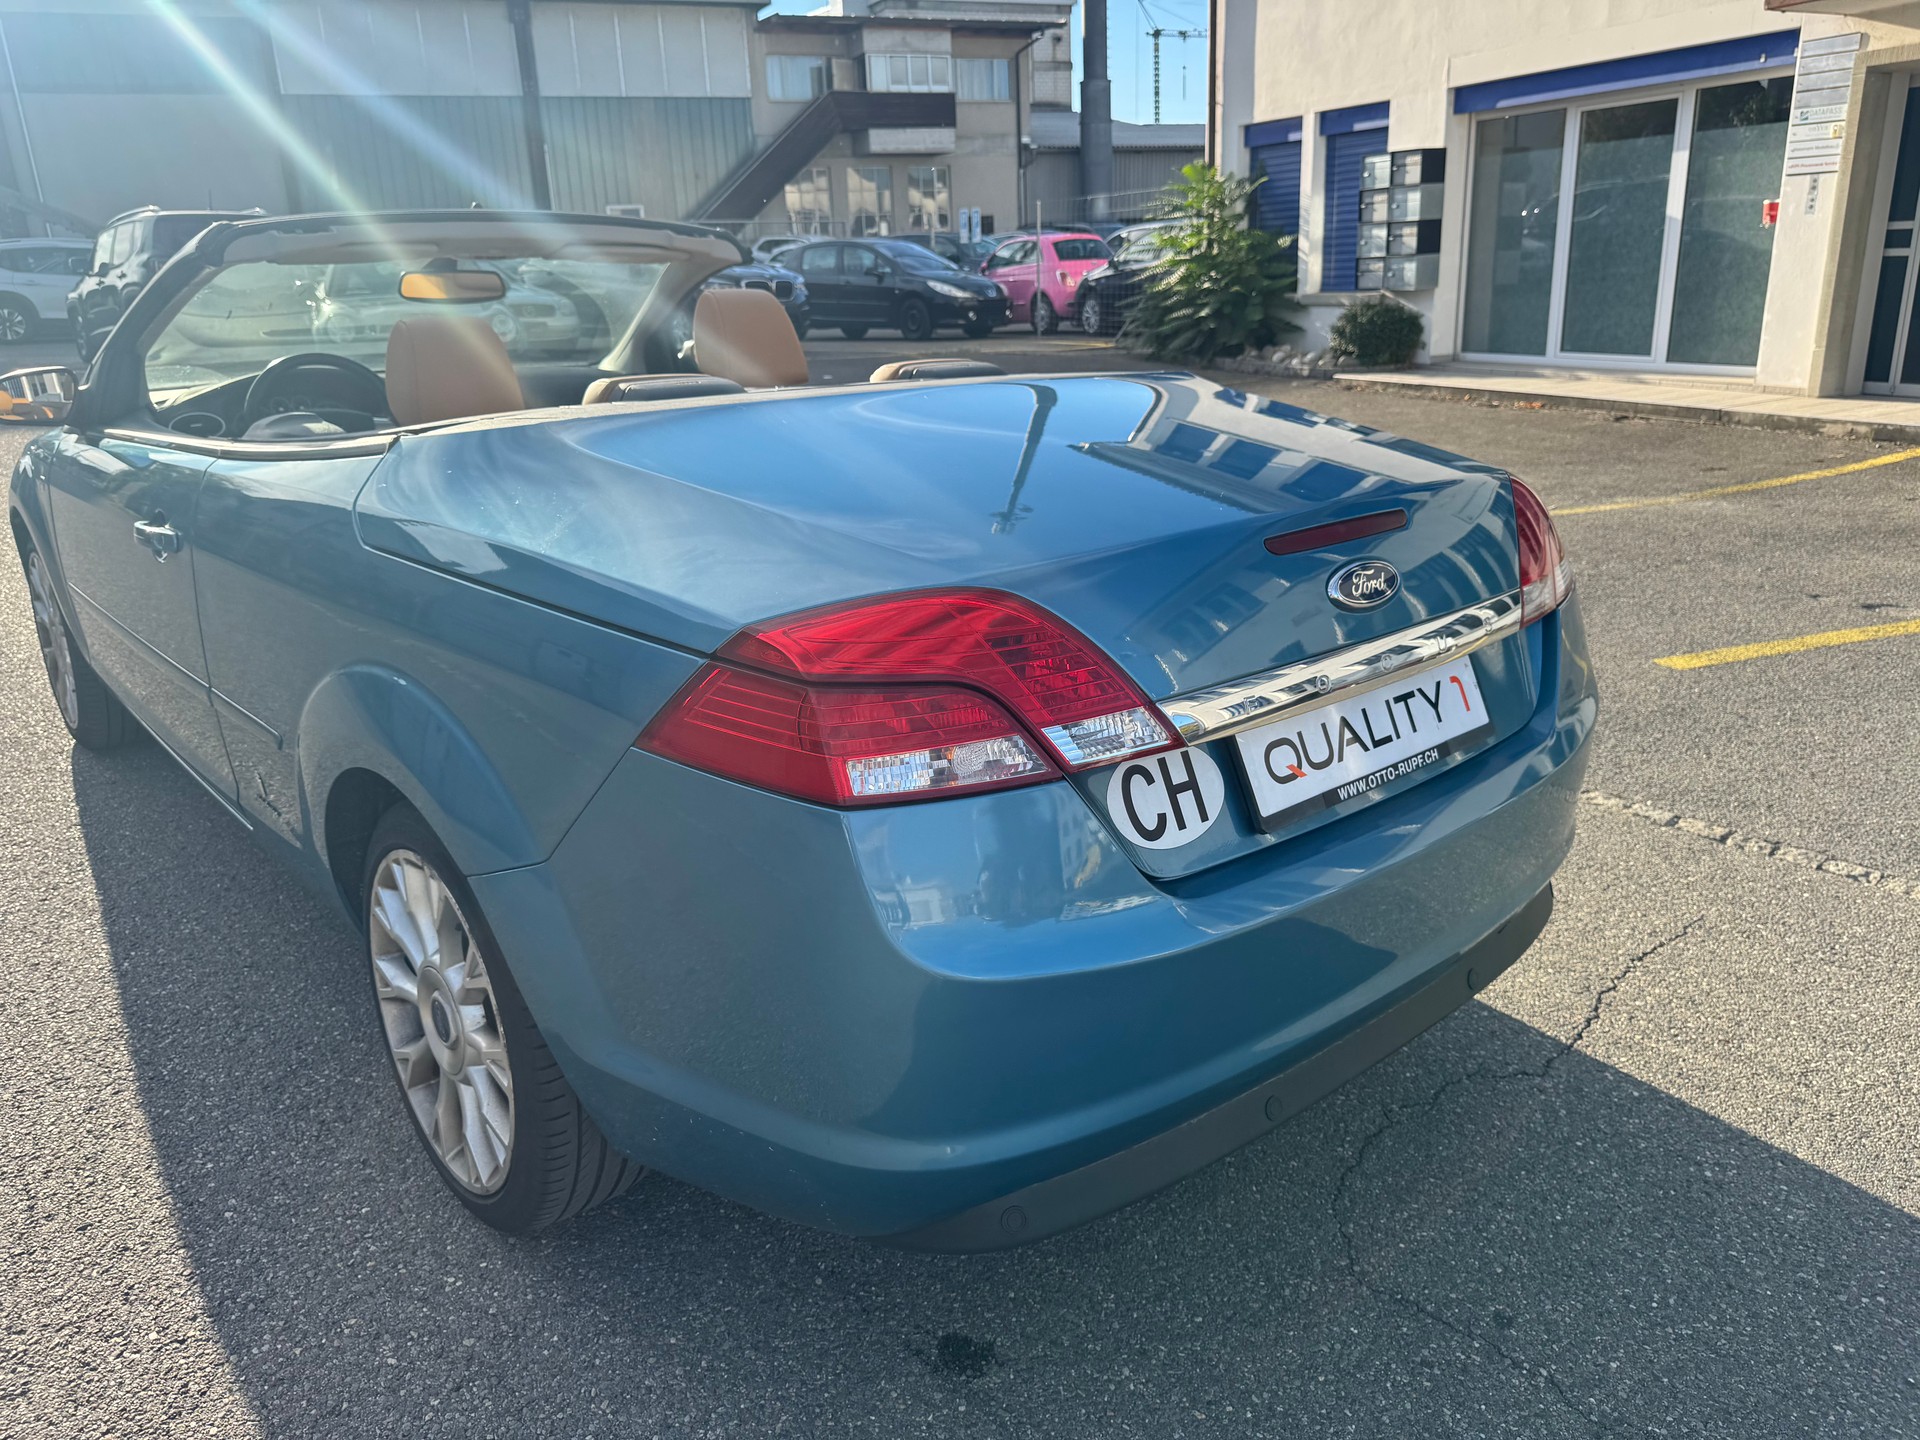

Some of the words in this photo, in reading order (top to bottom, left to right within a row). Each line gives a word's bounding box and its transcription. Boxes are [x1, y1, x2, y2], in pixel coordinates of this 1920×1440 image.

[1352, 569, 1387, 597] Ford
[1121, 750, 1209, 841] CH
[1337, 748, 1438, 801] WWW.OTTO-RUPF.CH
